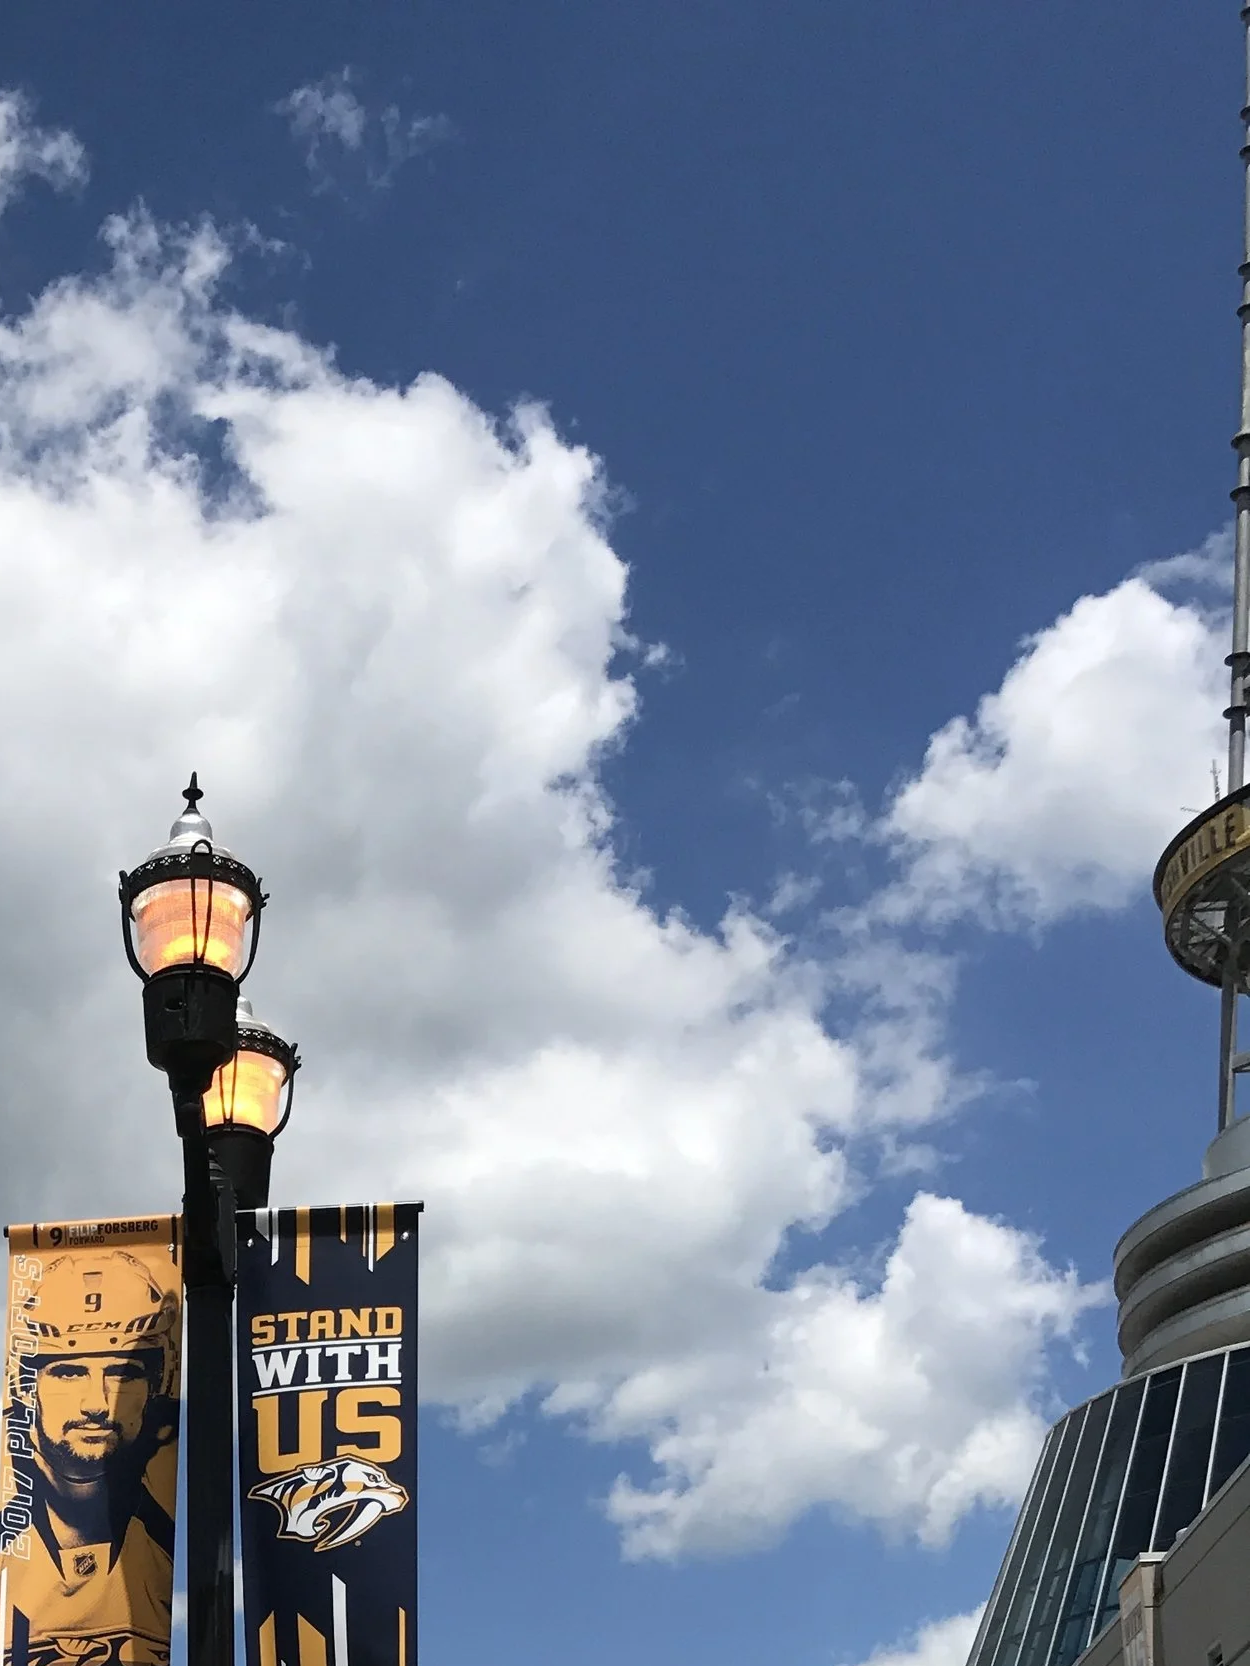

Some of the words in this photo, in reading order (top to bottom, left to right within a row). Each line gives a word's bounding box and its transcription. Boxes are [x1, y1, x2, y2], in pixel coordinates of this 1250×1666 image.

[50, 1227, 62, 1247] 9
[69, 1236, 105, 1246] FORWARD
[98, 1220, 159, 1236] FORSBERG
[84, 1293, 103, 1313] 9
[67, 1321, 122, 1333] CCM
[252, 1307, 402, 1346] STAND
[5, 1254, 43, 1460] PLAYOFFS
[252, 1344, 402, 1389] WITH
[252, 1387, 402, 1474] US
[0, 1466, 33, 1561] 2017
